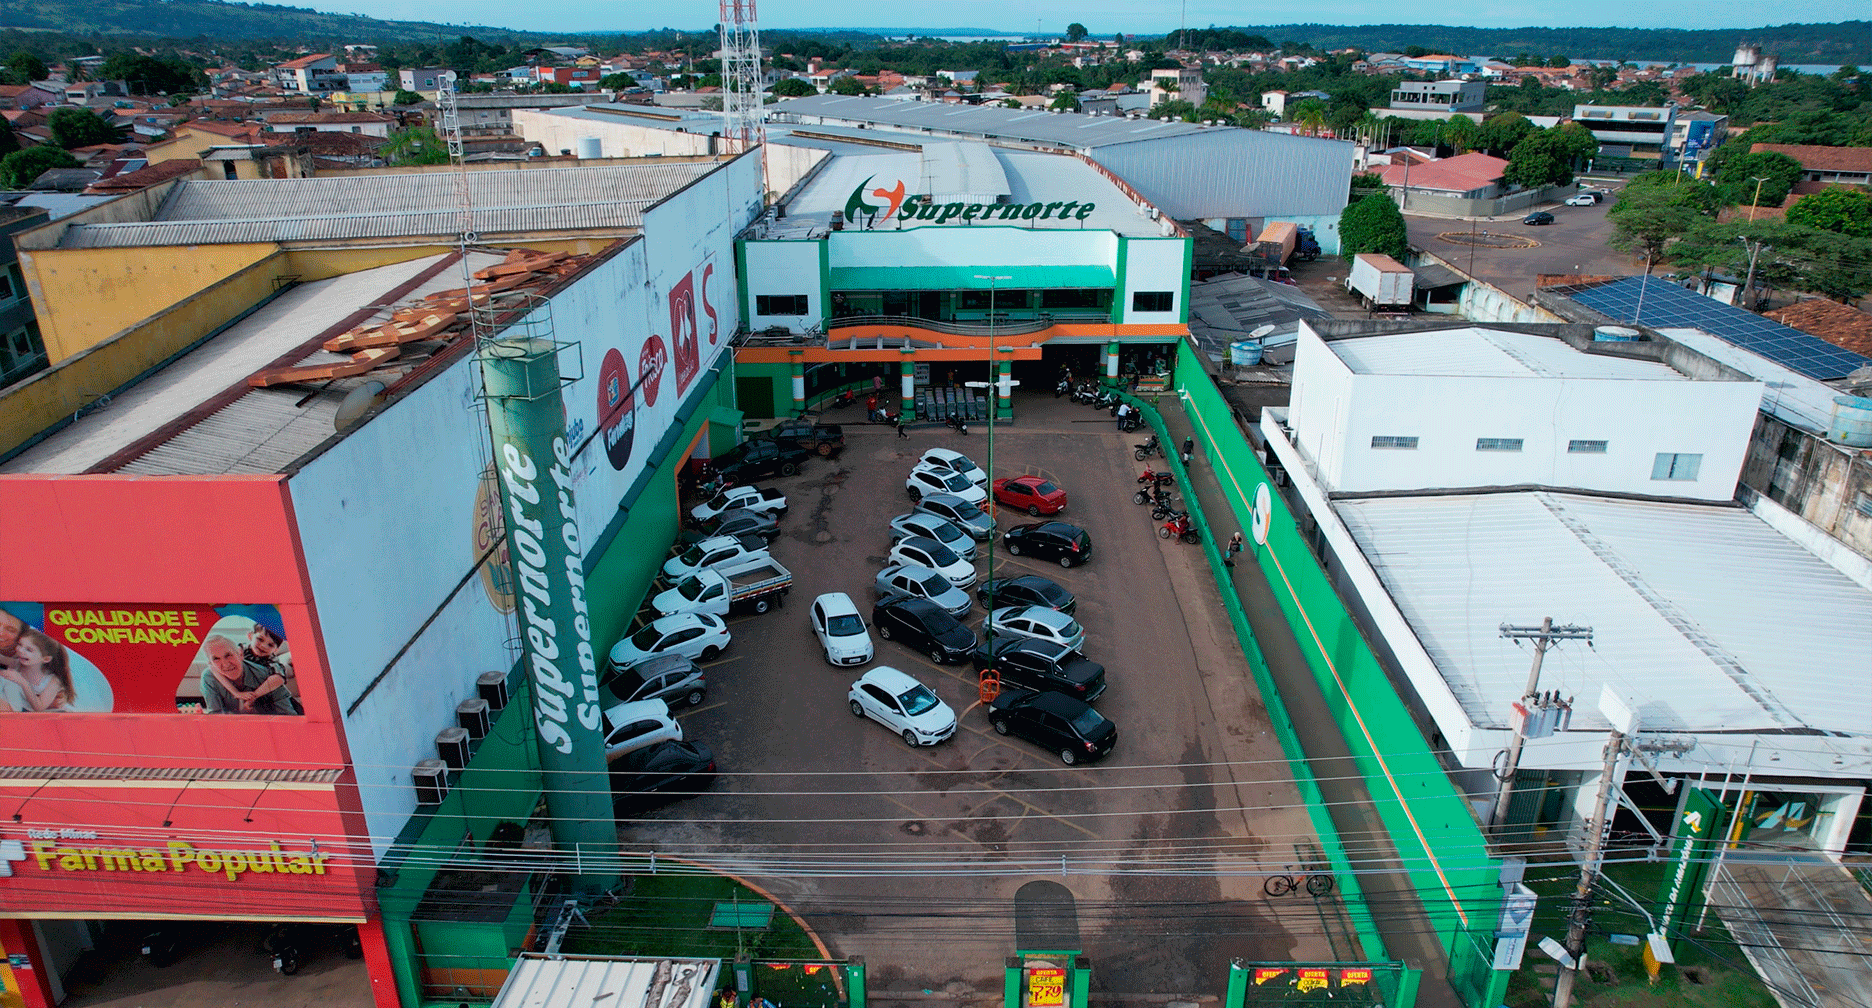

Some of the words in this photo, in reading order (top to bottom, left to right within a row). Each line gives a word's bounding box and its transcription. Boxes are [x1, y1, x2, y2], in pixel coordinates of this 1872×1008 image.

[898, 194, 1095, 223] Supernorte
[501, 443, 575, 754] Supernorte
[49, 610, 183, 627] QUALIDADE
[183, 611, 200, 627] E
[64, 627, 199, 647] CONFIANÇA
[31, 840, 166, 873] Farma
[167, 840, 329, 880] Popular
